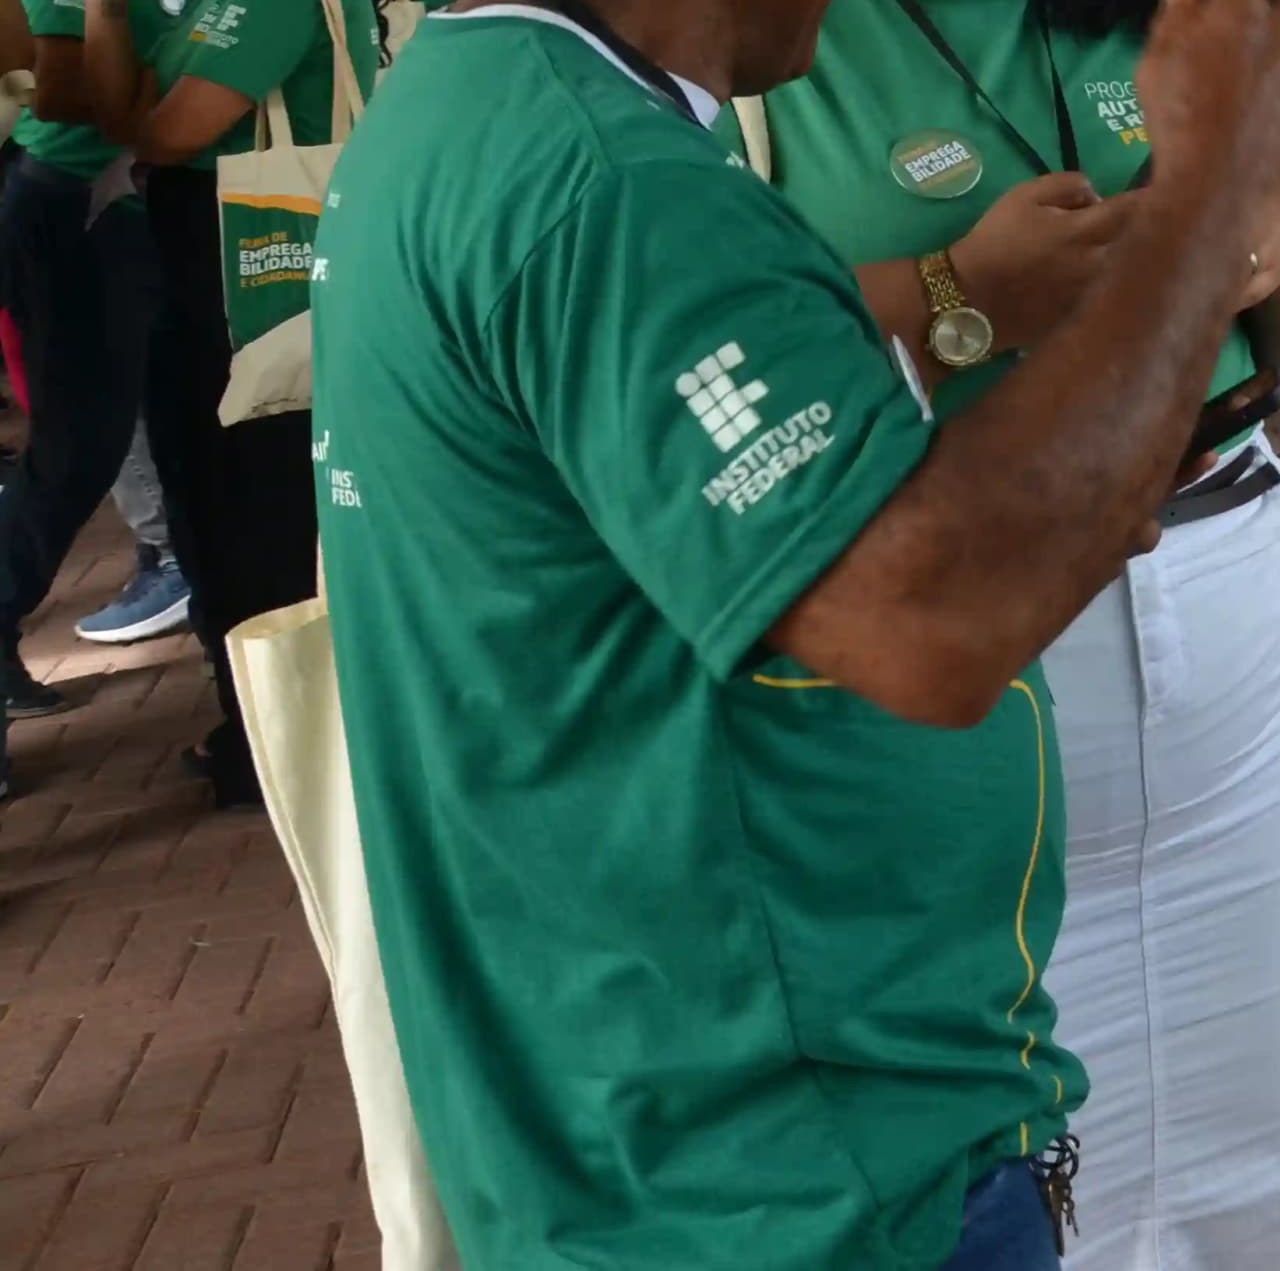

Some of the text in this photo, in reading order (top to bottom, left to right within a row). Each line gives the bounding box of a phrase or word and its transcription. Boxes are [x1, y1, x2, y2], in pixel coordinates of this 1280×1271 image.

[1084, 81, 1139, 100] PROG
[1097, 98, 1138, 118] AUT
[1106, 118, 1124, 131] E
[905, 140, 963, 172] EMPREGA
[911, 149, 971, 182] BILIDADE
[272, 232, 288, 241] DE
[240, 243, 312, 262] EMPREGA
[701, 401, 832, 506] INSTITUTO
[726, 430, 835, 515] FEDERAL
